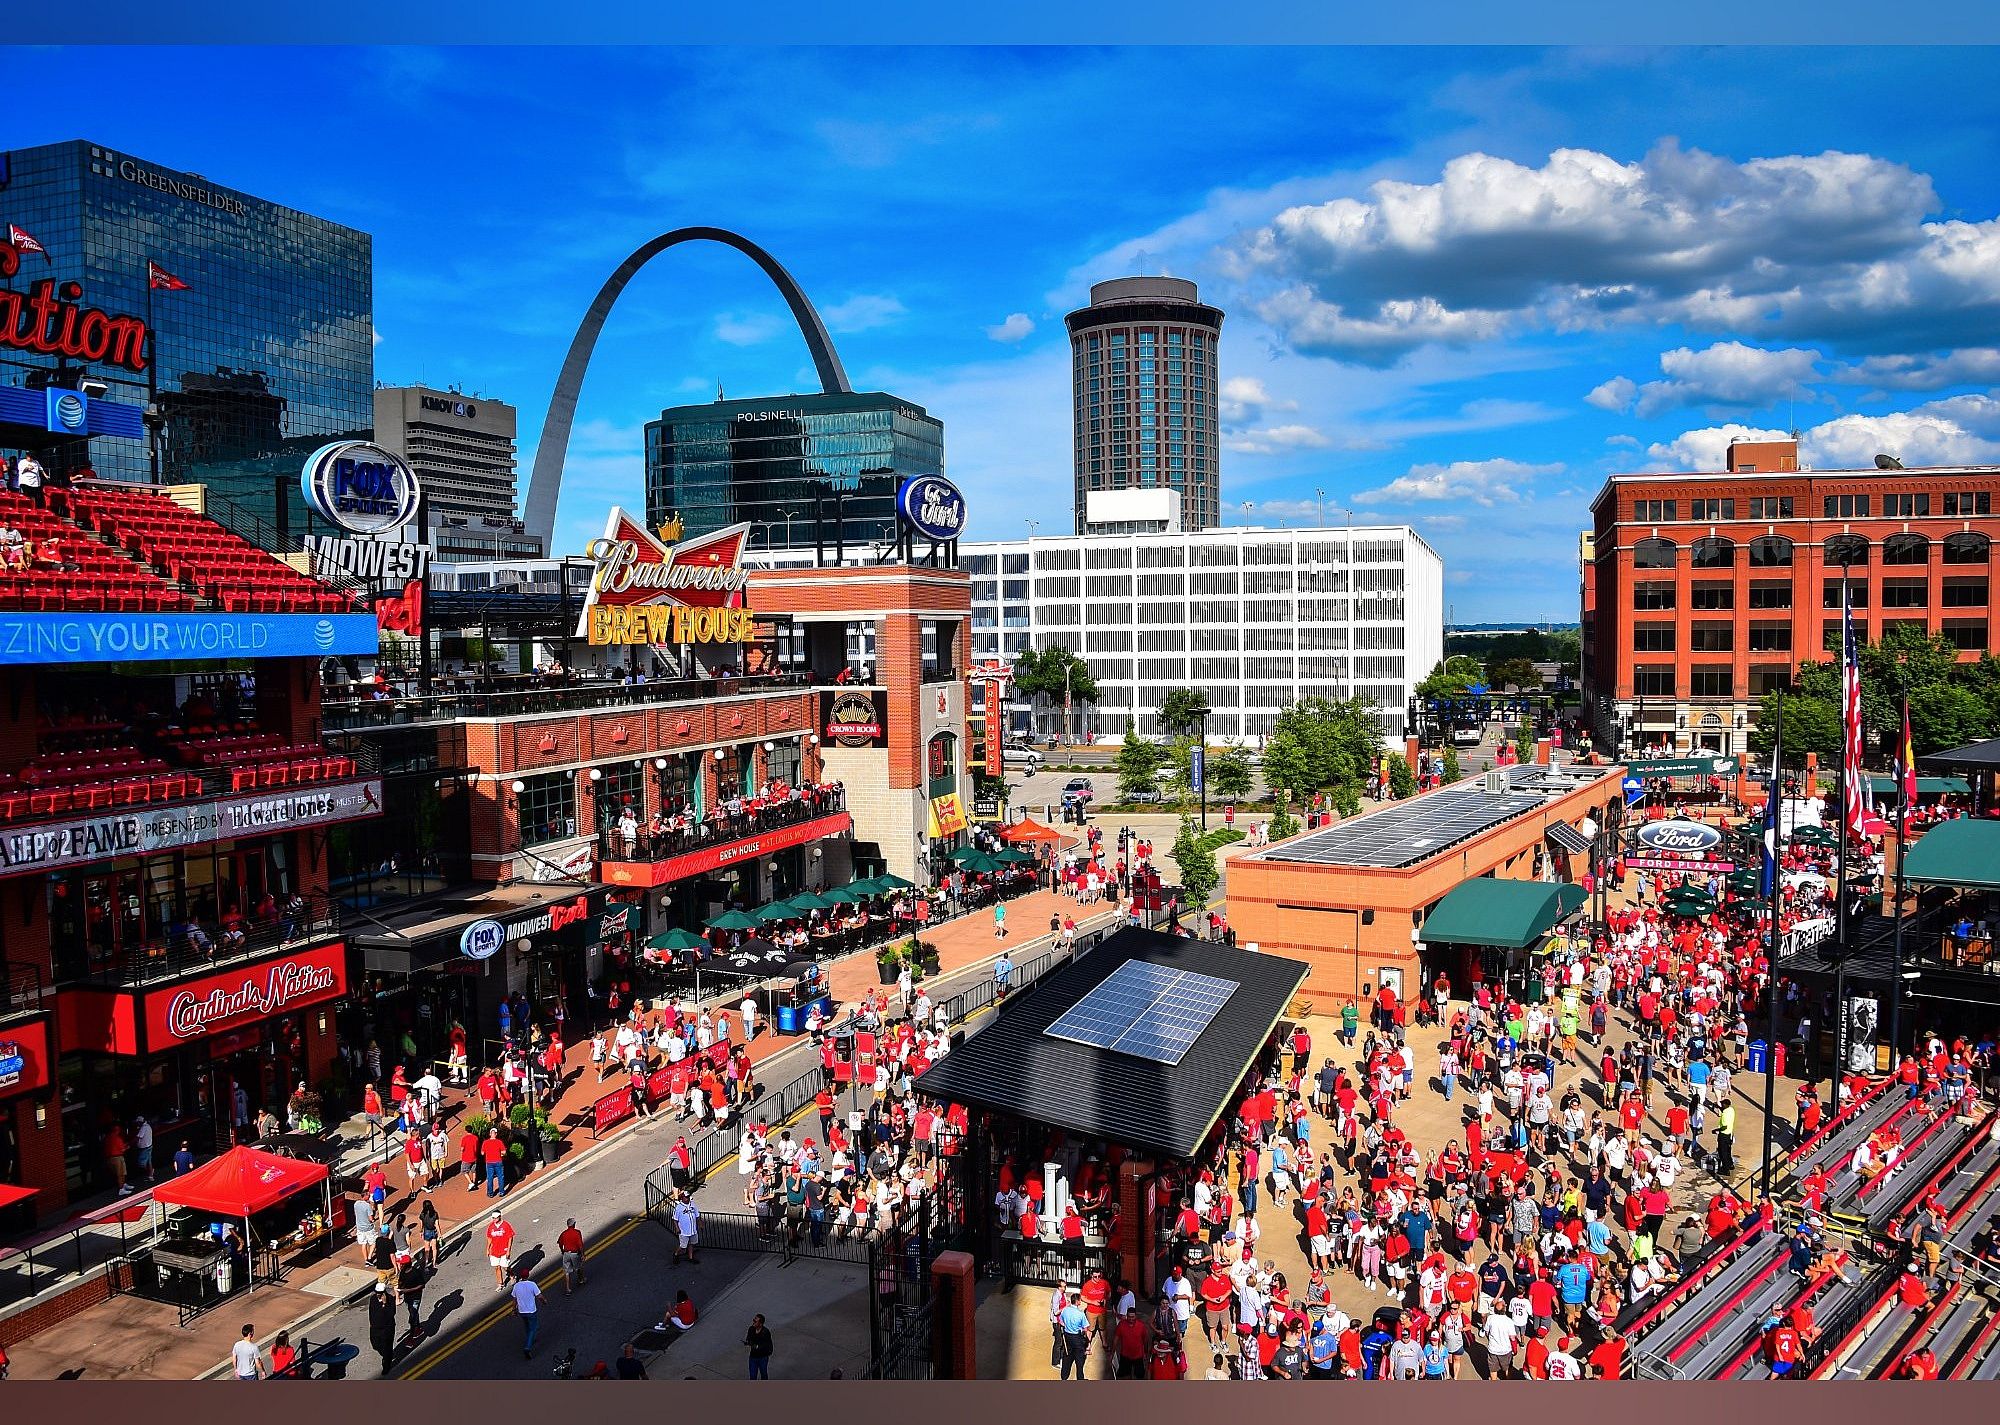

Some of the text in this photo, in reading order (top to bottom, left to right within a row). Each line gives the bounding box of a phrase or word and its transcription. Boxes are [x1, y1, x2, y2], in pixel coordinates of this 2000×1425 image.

[120, 161, 245, 216] GREENSFELDER
[421, 395, 454, 413] KMOV
[737, 408, 803, 423] POLSINELLI
[335, 458, 399, 501] FOX
[921, 483, 959, 528] Ford
[303, 534, 431, 579] MIDWEST
[586, 538, 750, 593] Budweiser
[589, 604, 755, 646] BREW HOUSE
[88, 622, 170, 651] YOUR
[987, 724, 996, 772] HOUSE
[69, 818, 140, 857] FAME
[145, 815, 208, 838] PRESENTED
[211, 812, 225, 828] BY
[1653, 825, 1704, 847] Ford
[719, 847, 738, 862] BREW
[739, 840, 760, 854] HOUSE
[1639, 859, 1720, 871] FORD PLAZA
[474, 926, 495, 947] FOX
[506, 913, 553, 942] MIDWEST
[474, 941, 496, 953] SPORTS
[169, 961, 334, 1038] Cardinals Nation
[1659, 1163, 1671, 1174] 52
[1573, 1274, 1579, 1286] 1
[1514, 1308, 1523, 1317] 15
[1781, 1340, 1790, 1352] 4
[1552, 1365, 1566, 1379] 25
